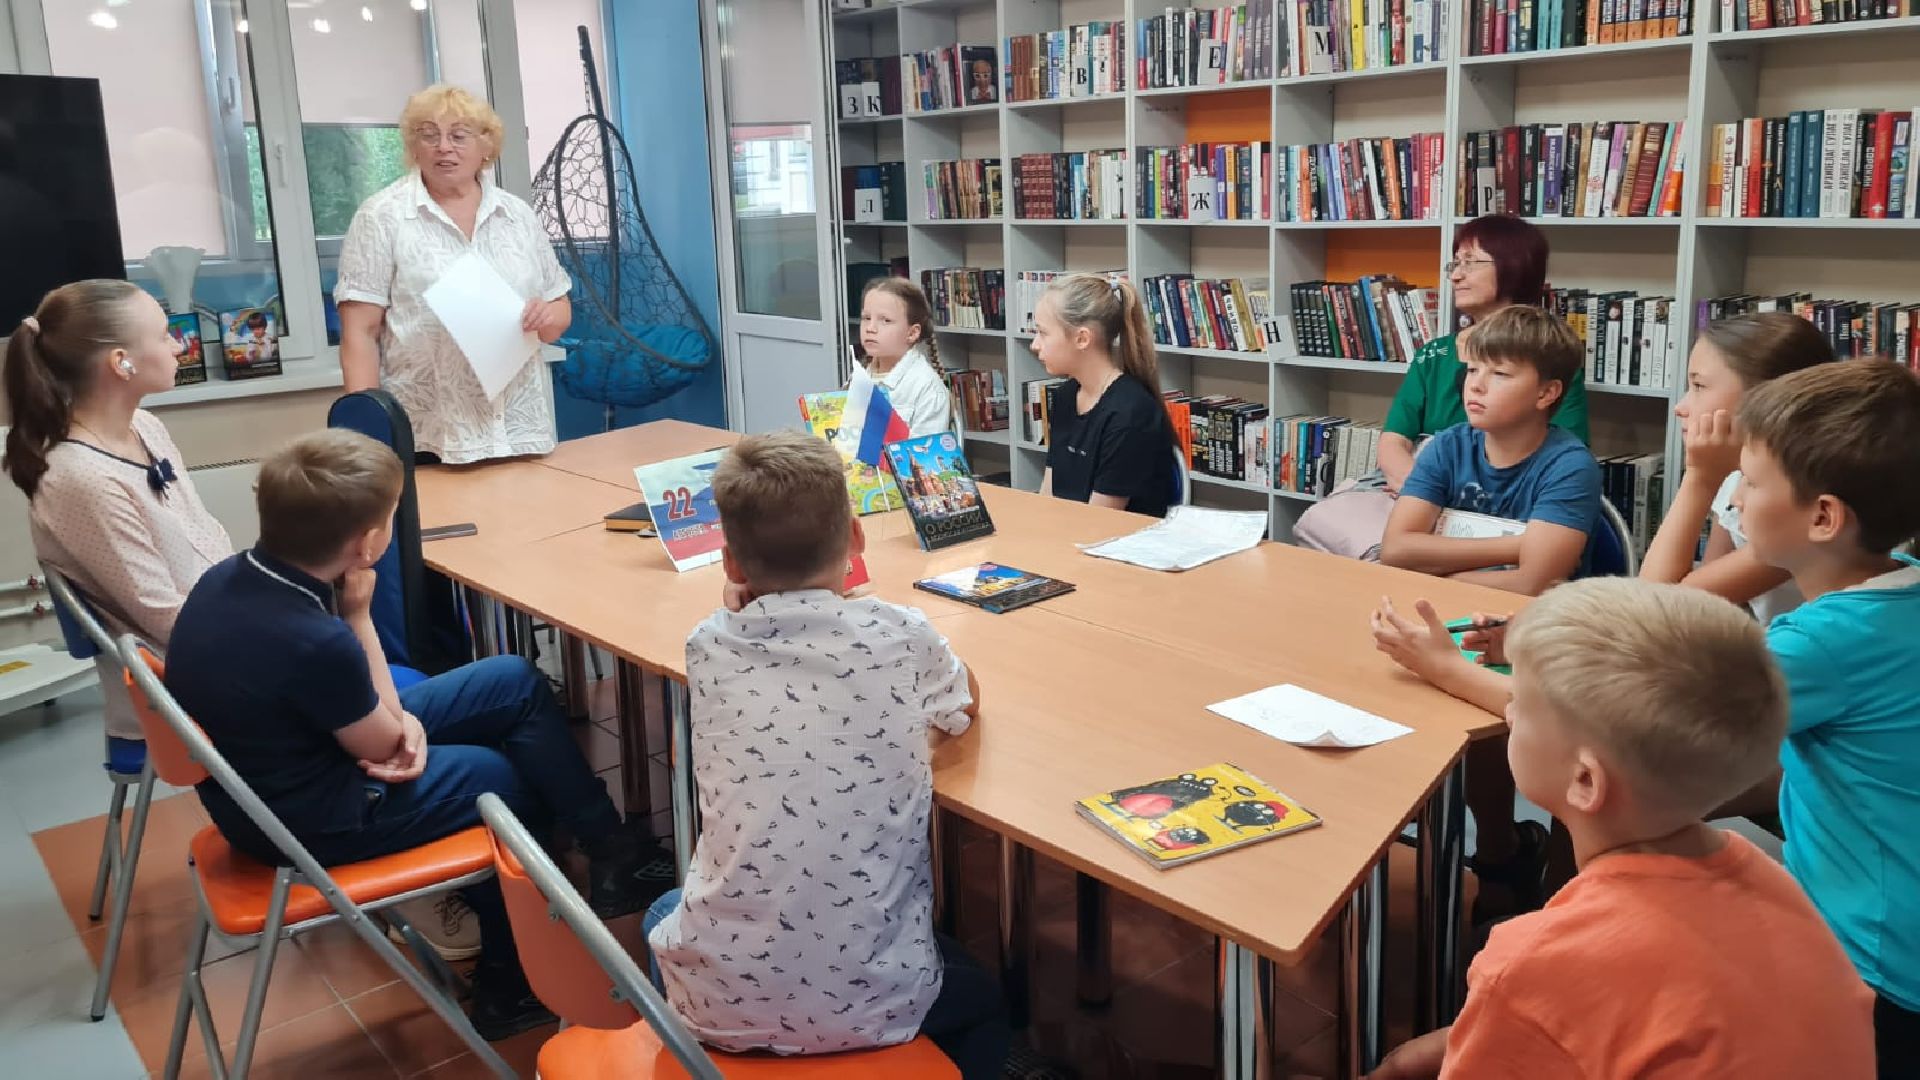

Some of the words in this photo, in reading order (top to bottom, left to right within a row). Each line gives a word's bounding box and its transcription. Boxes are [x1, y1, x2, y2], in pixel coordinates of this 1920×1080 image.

[1077, 68, 1087, 84] В
[1191, 192, 1210, 210] Ж
[1484, 186, 1493, 212] Р
[1264, 321, 1281, 344] Н
[662, 486, 697, 521] 22
